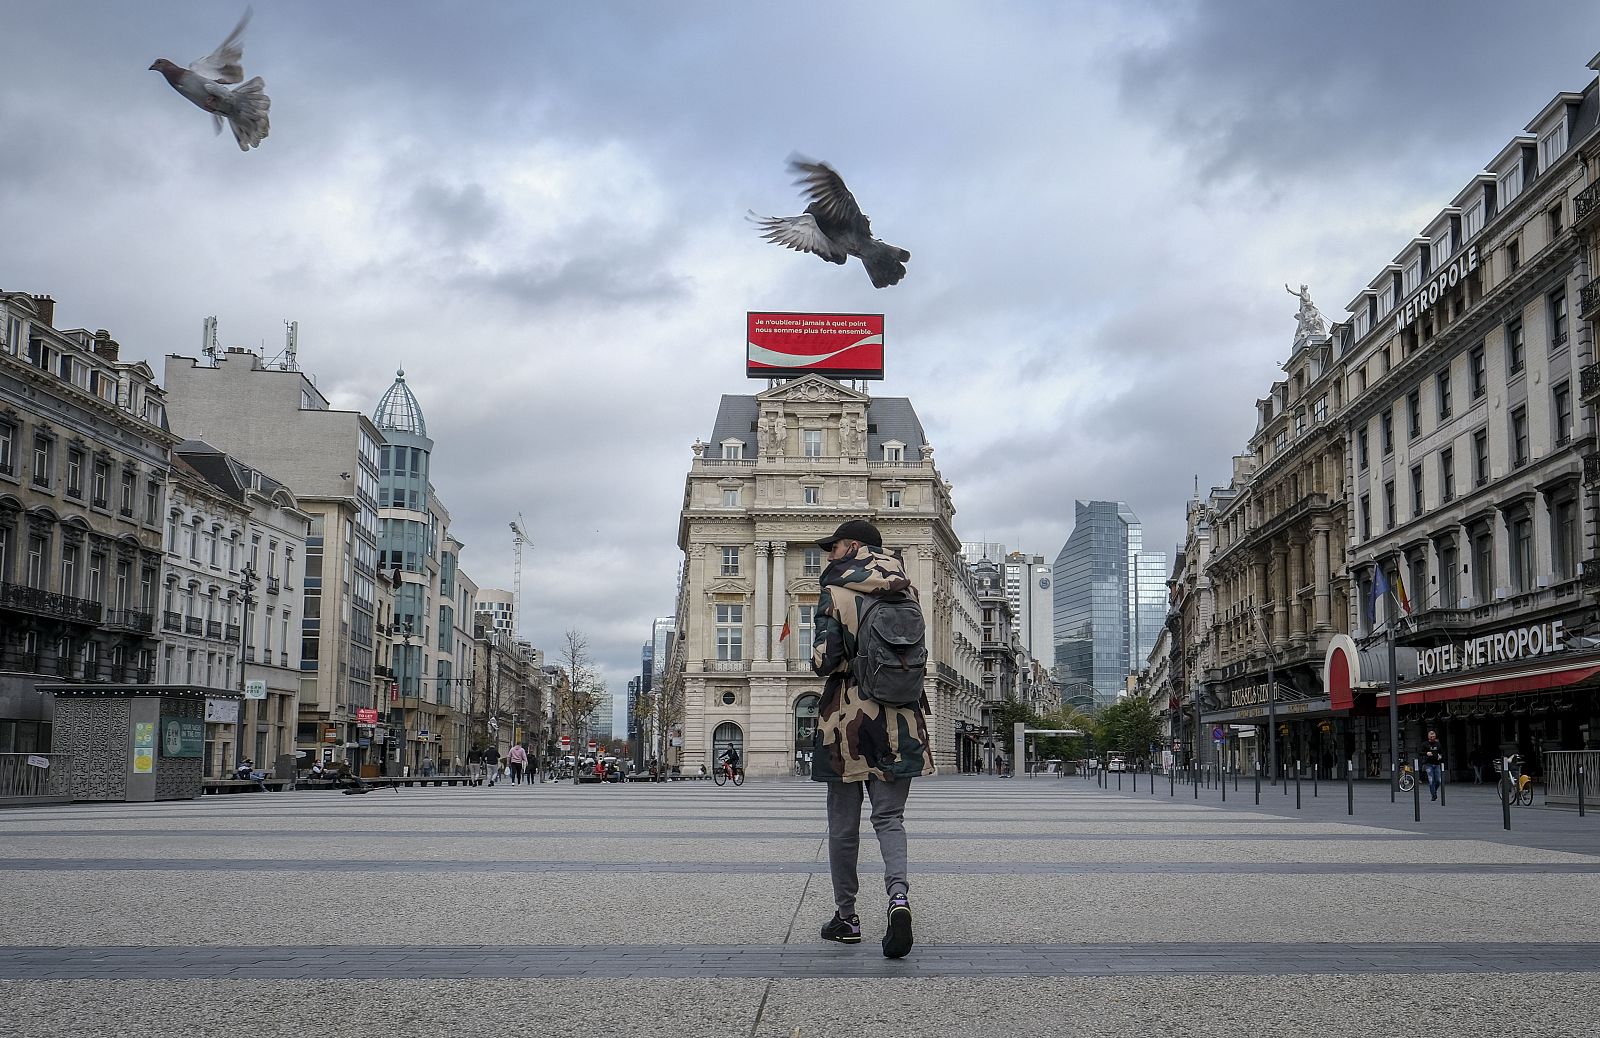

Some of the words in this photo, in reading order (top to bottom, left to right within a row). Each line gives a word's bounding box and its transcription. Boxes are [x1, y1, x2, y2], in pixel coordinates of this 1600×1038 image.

[1396, 245, 1478, 333] METROPOLE
[765, 318, 801, 326] n'oublierai
[801, 319, 825, 327] jamais
[831, 320, 848, 328] quel
[848, 320, 867, 328] point
[1416, 643, 1458, 676] HOTEL
[1464, 620, 1564, 667] METROPOLE
